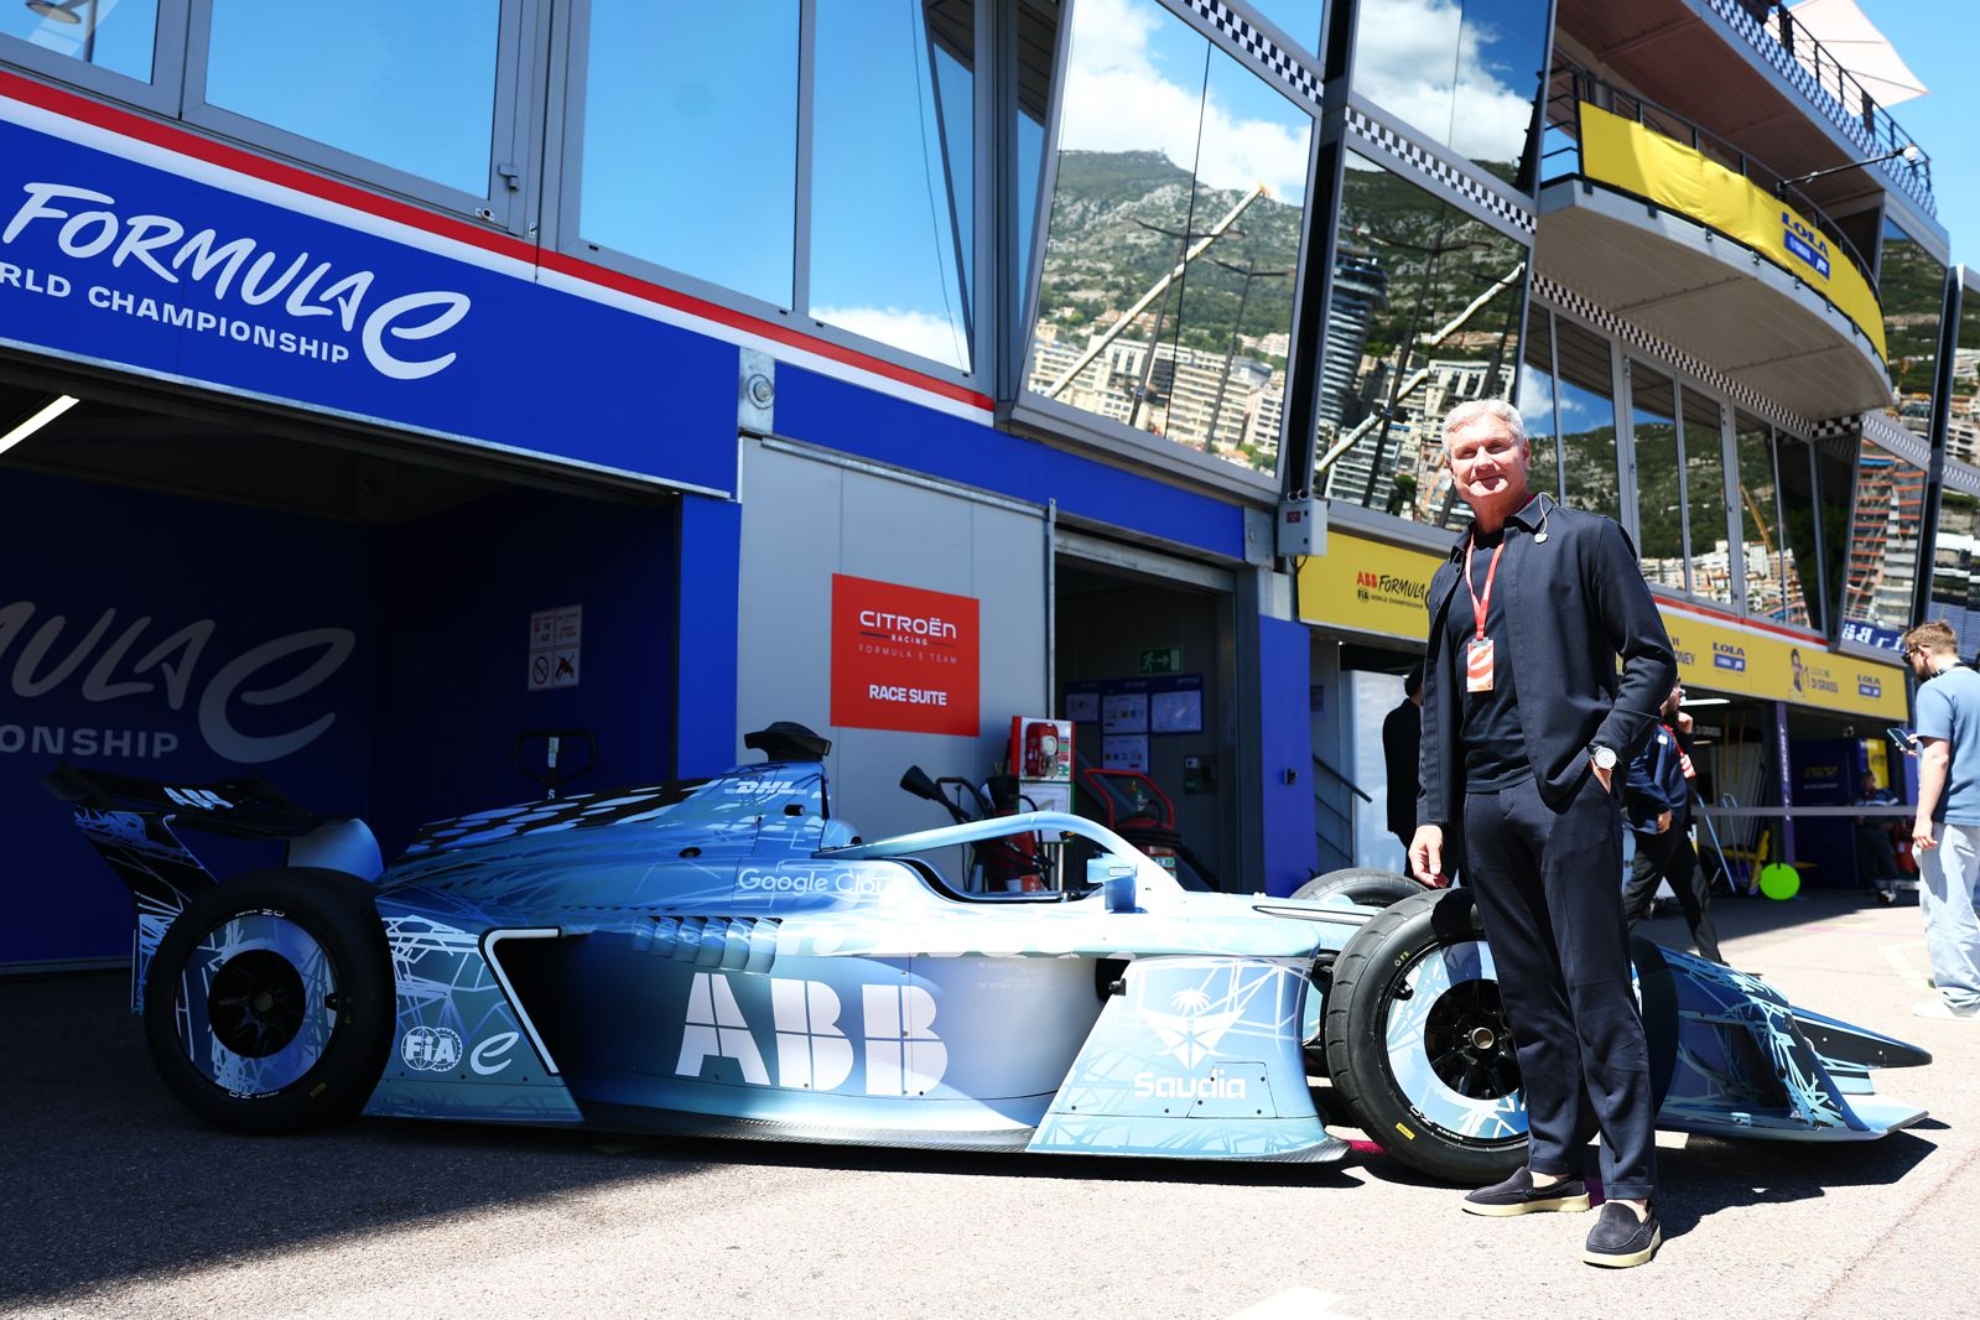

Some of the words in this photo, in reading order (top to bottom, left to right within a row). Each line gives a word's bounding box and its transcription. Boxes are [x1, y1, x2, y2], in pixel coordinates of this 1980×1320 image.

[1782, 210, 1830, 258] LOLA
[2, 182, 374, 332] FORMULA
[88, 285, 349, 363] CHAMPIONSHIP
[1357, 571, 1378, 588] ABB
[1379, 575, 1425, 600] FORMULA
[859, 643, 912, 658] FORMULA
[918, 651, 924, 660] E
[930, 653, 957, 664] TEAM
[891, 634, 928, 646] RACING
[1712, 642, 1745, 656] LOLA
[1857, 673, 1881, 686] LOLA
[869, 684, 907, 702] RACE
[909, 688, 947, 706] SUITE
[736, 780, 796, 794] DHL
[739, 868, 828, 896] Google
[675, 972, 948, 1096] ABB
[1134, 1070, 1246, 1099] Saudia
